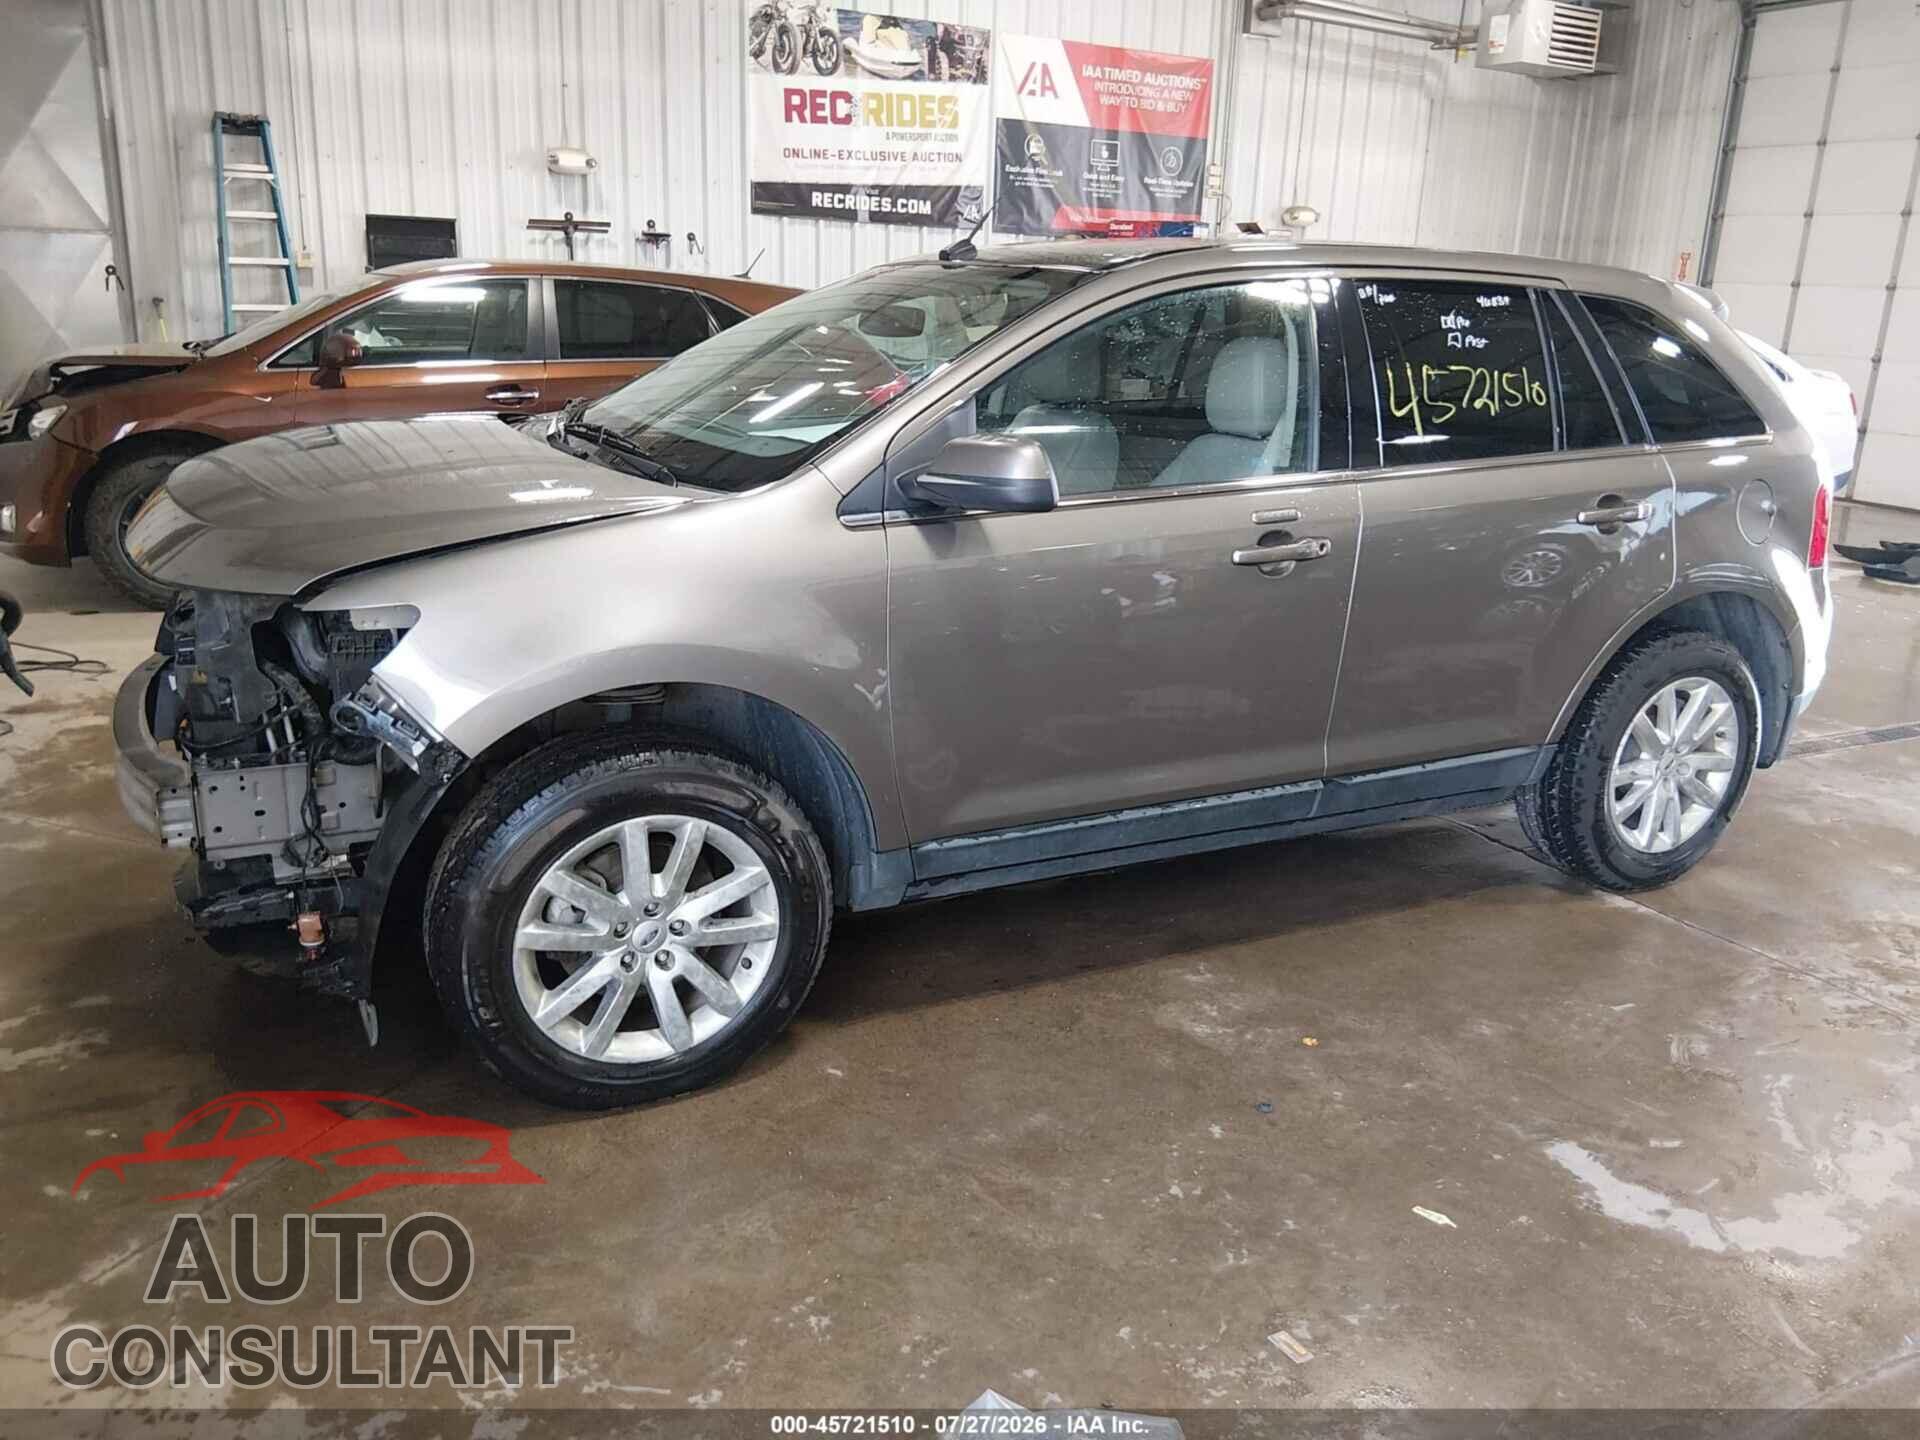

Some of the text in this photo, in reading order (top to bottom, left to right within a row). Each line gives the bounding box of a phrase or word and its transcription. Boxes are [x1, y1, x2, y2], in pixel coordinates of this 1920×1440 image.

[1082, 64, 1102, 78] IAA
[1103, 67, 1141, 83] TIMED
[783, 87, 960, 129] REC RIDES
[1100, 94, 1121, 106] WAY
[1121, 96, 1138, 108] TO
[1167, 102, 1187, 113] BUY
[783, 147, 964, 163] ONLINE-EXCLUSIVE AUCTION
[811, 191, 932, 215] RECRIDES.COM
[1385, 359, 1547, 438] 45721510
